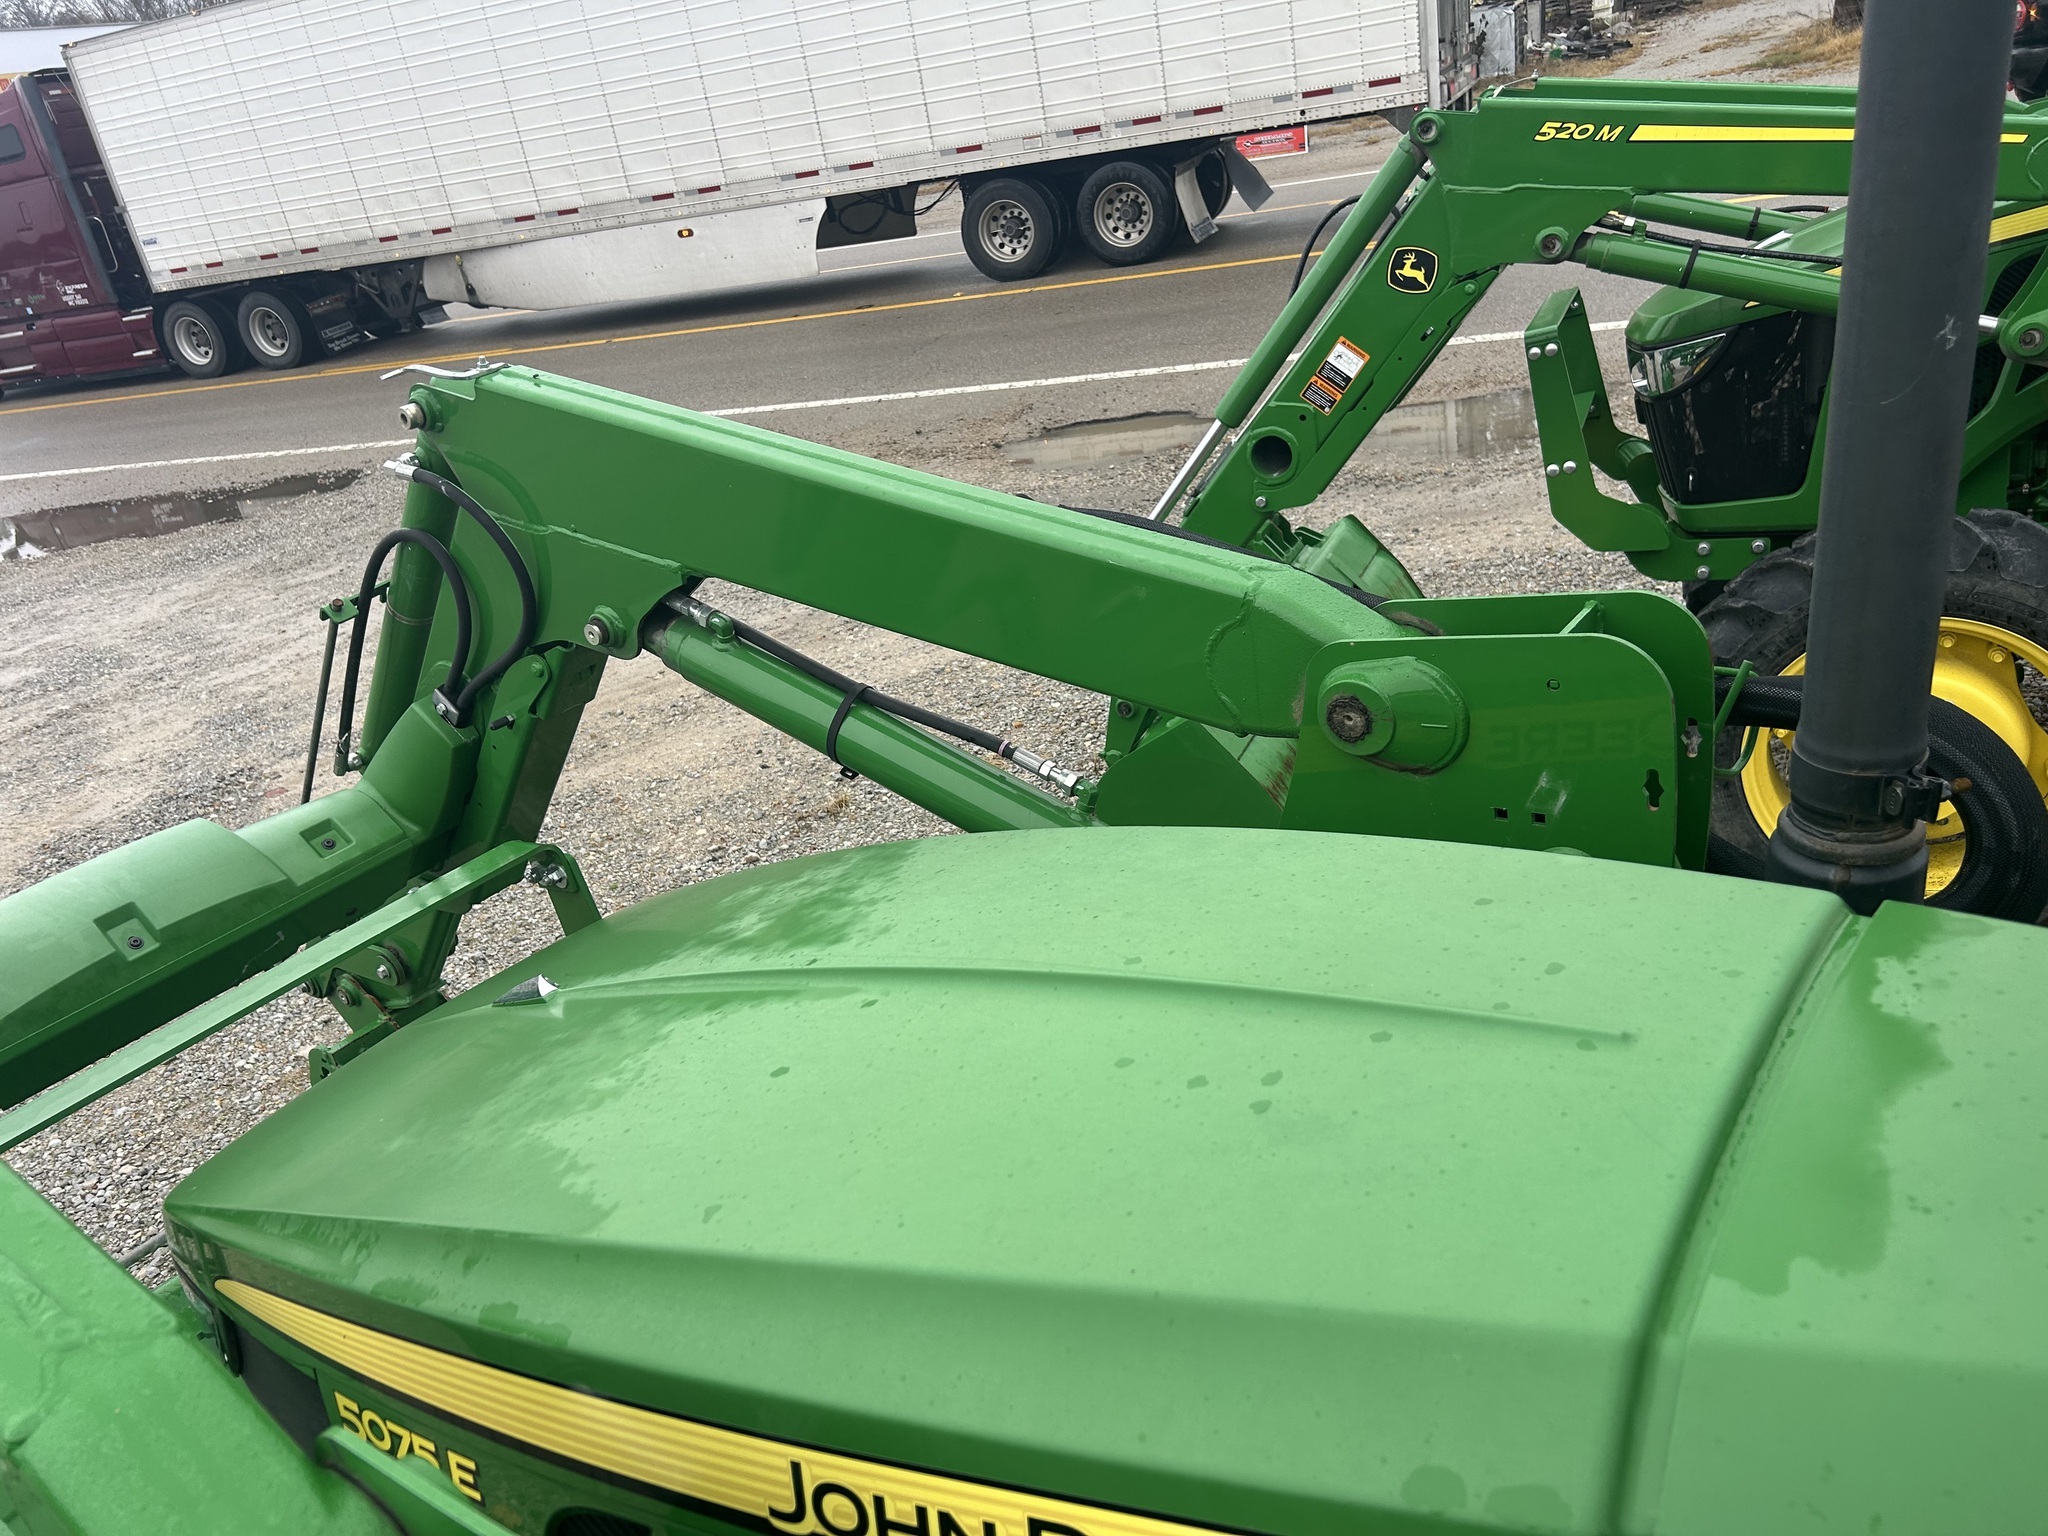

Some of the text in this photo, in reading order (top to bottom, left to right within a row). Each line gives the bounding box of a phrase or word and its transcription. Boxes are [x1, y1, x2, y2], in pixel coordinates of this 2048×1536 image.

[1533, 121, 1625, 142] 520 M
[1346, 343, 1366, 359] WARNING
[1319, 383, 1338, 398] WARNING
[334, 1391, 483, 1502] 5075 E
